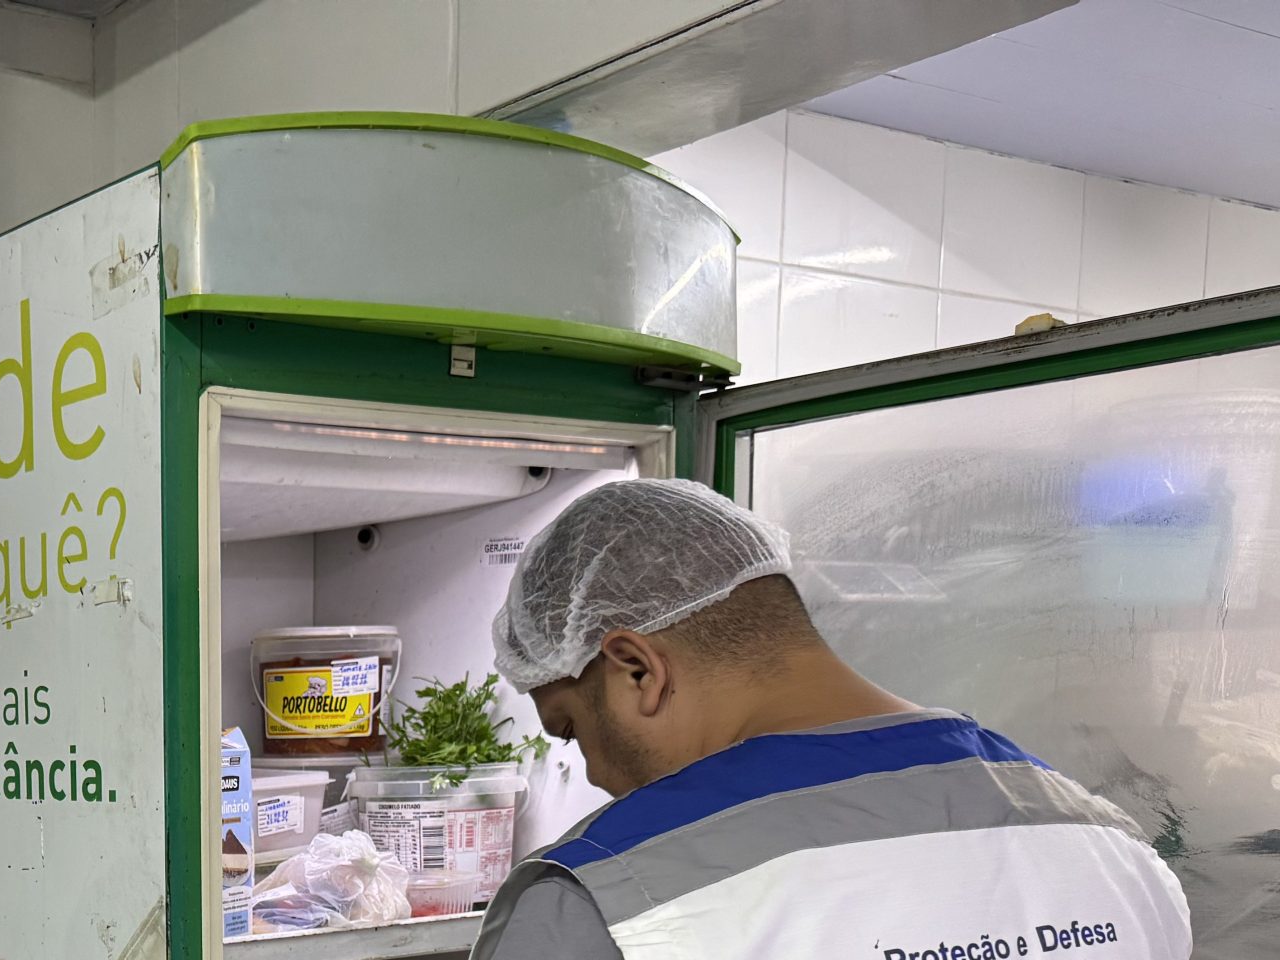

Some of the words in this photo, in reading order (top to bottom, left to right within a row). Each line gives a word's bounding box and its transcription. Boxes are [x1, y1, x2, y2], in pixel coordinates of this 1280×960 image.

[282, 695, 348, 714] PORTOBELLO
[1017, 935, 1028, 957] e
[1036, 920, 1117, 953] Defesa
